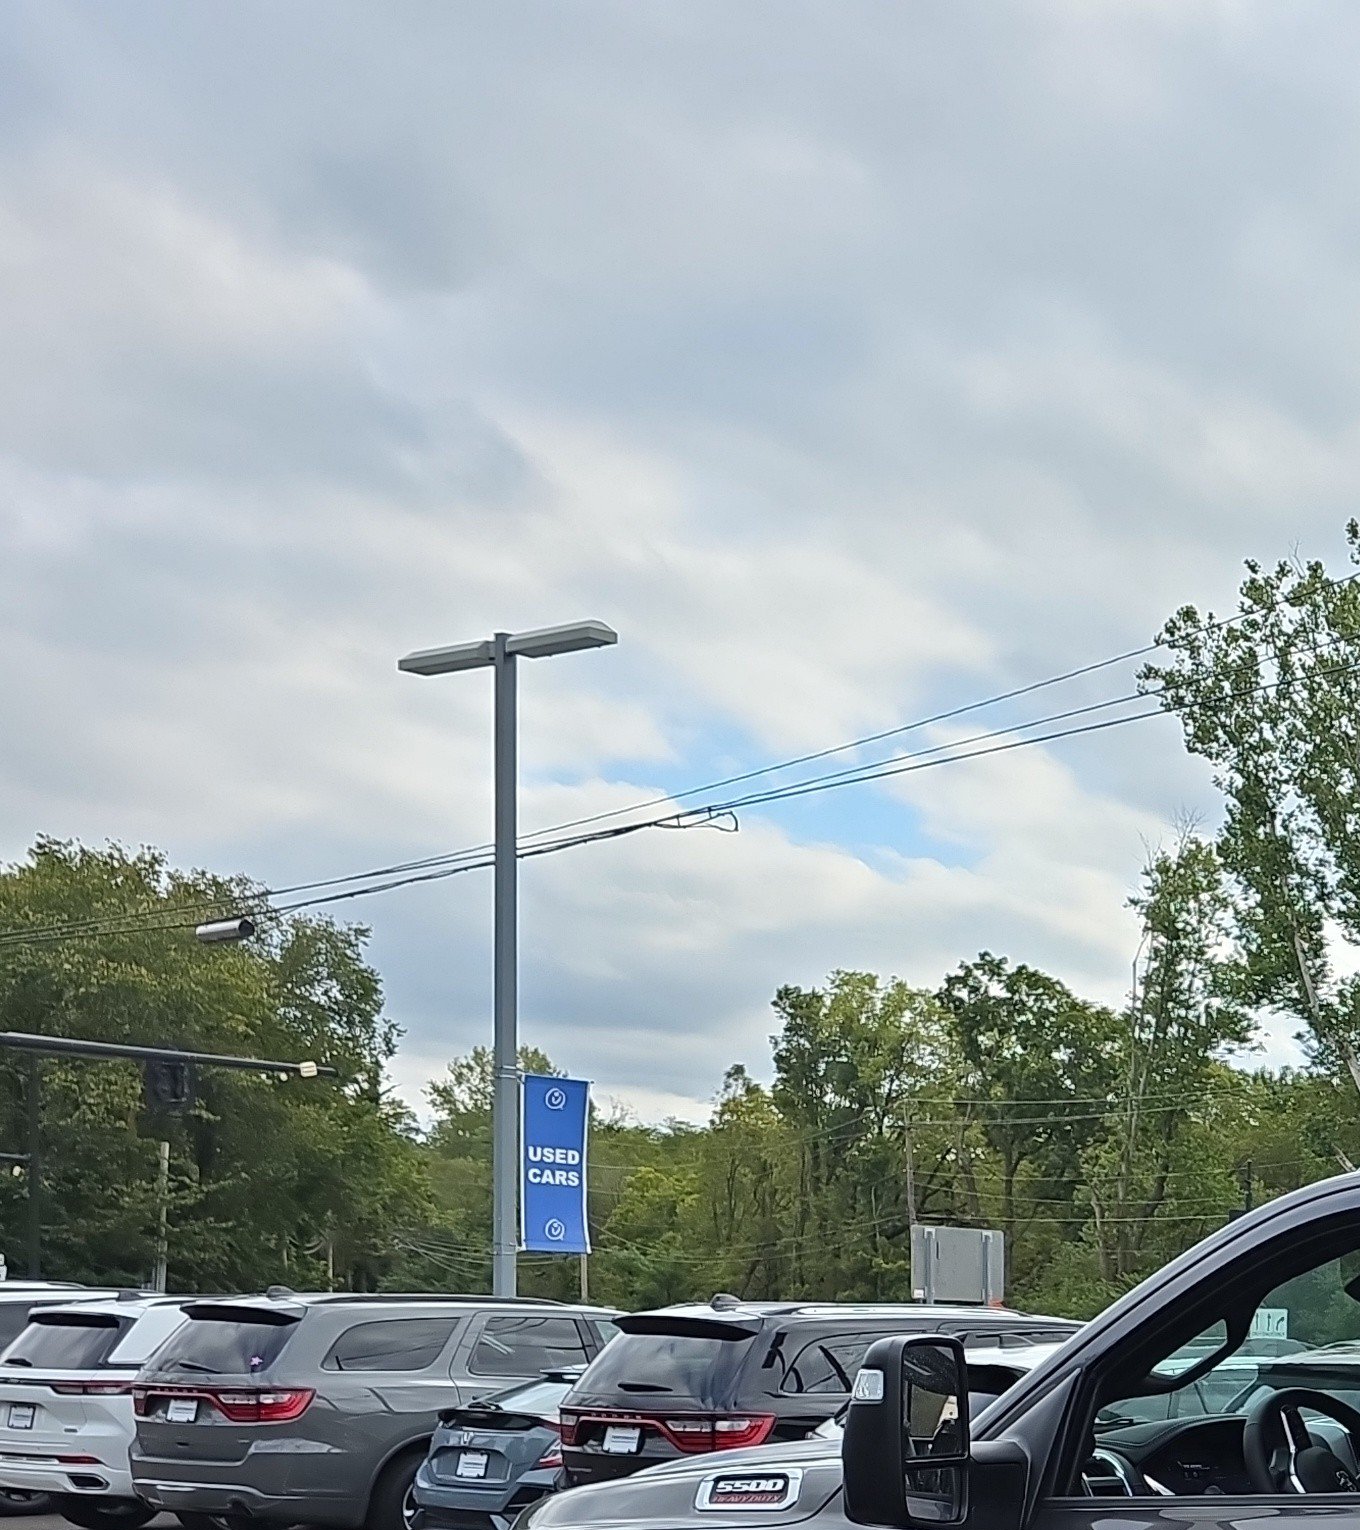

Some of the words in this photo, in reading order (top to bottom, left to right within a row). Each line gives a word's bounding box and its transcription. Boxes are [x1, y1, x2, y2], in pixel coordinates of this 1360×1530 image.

[528, 1146, 580, 1165] USED
[528, 1168, 580, 1187] CARS
[716, 1479, 785, 1492] 5500
